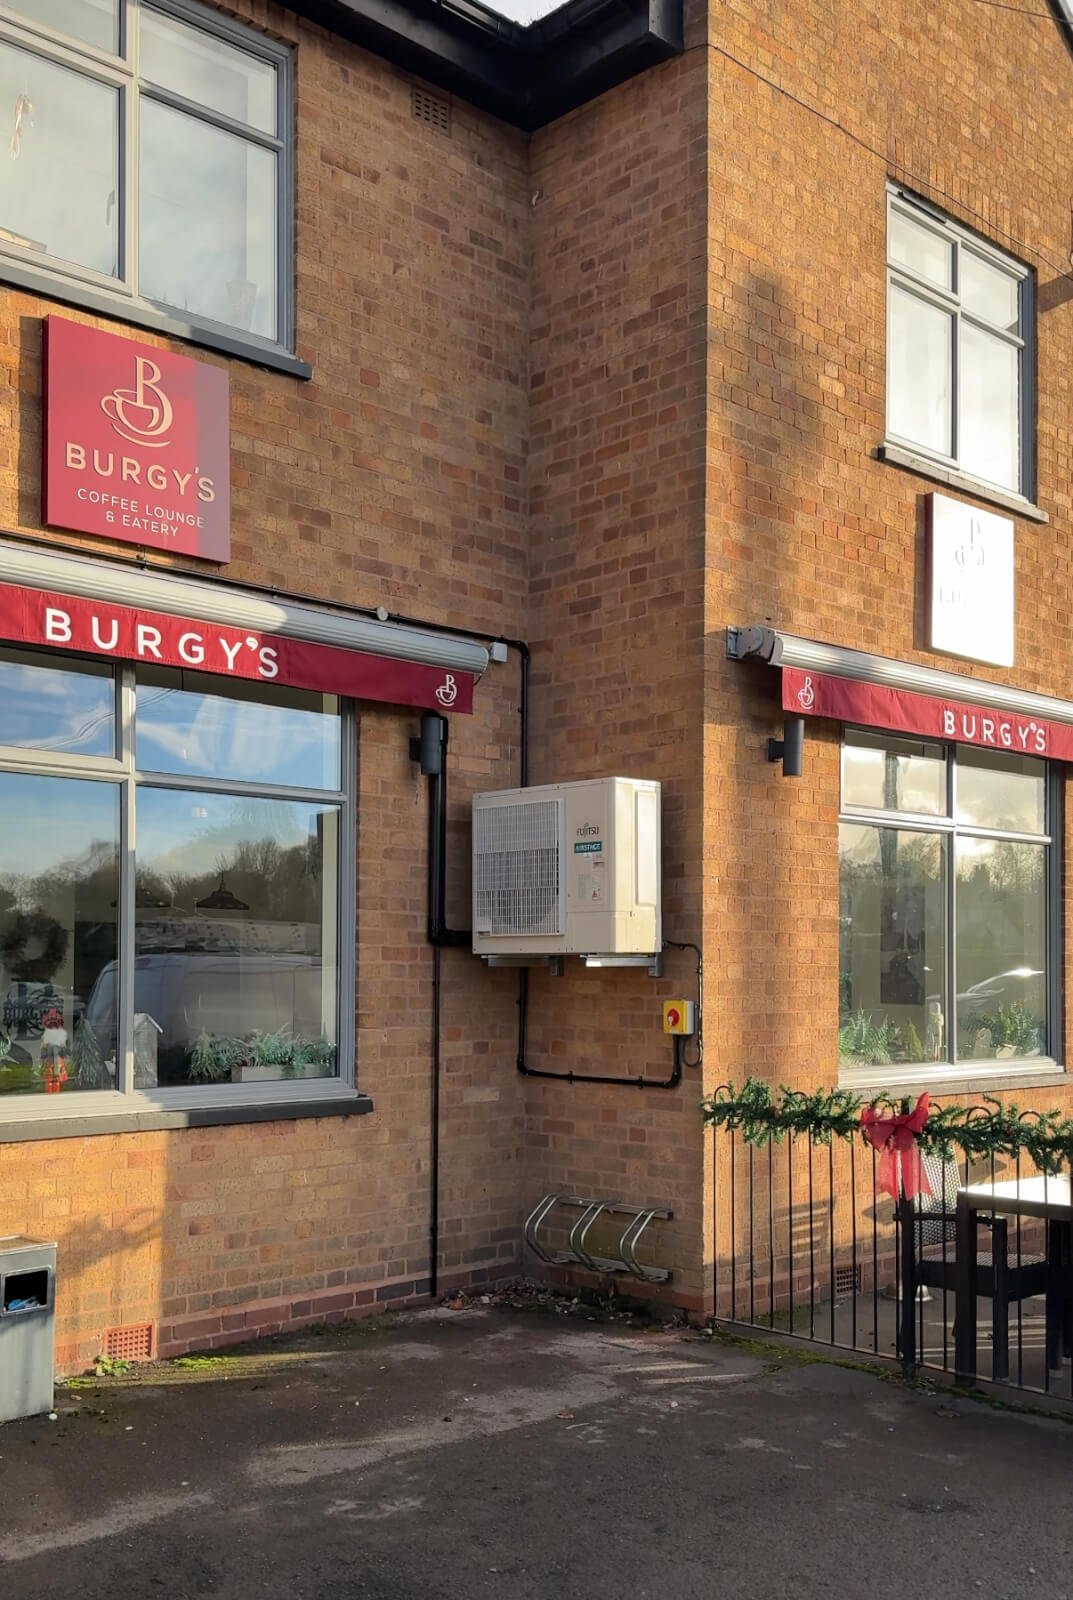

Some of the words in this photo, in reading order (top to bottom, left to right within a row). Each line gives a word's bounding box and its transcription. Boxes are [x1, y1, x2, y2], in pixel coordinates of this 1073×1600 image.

[65, 441, 217, 503] BURGY'S
[77, 488, 139, 513] COFFEE
[145, 503, 206, 529] LOUNGE
[105, 510, 115, 523] &
[122, 514, 179, 537] EATERY
[45, 607, 279, 678] BURGY'S
[943, 710, 1047, 752] BURGY'S
[576, 824, 600, 837] FUJITSU
